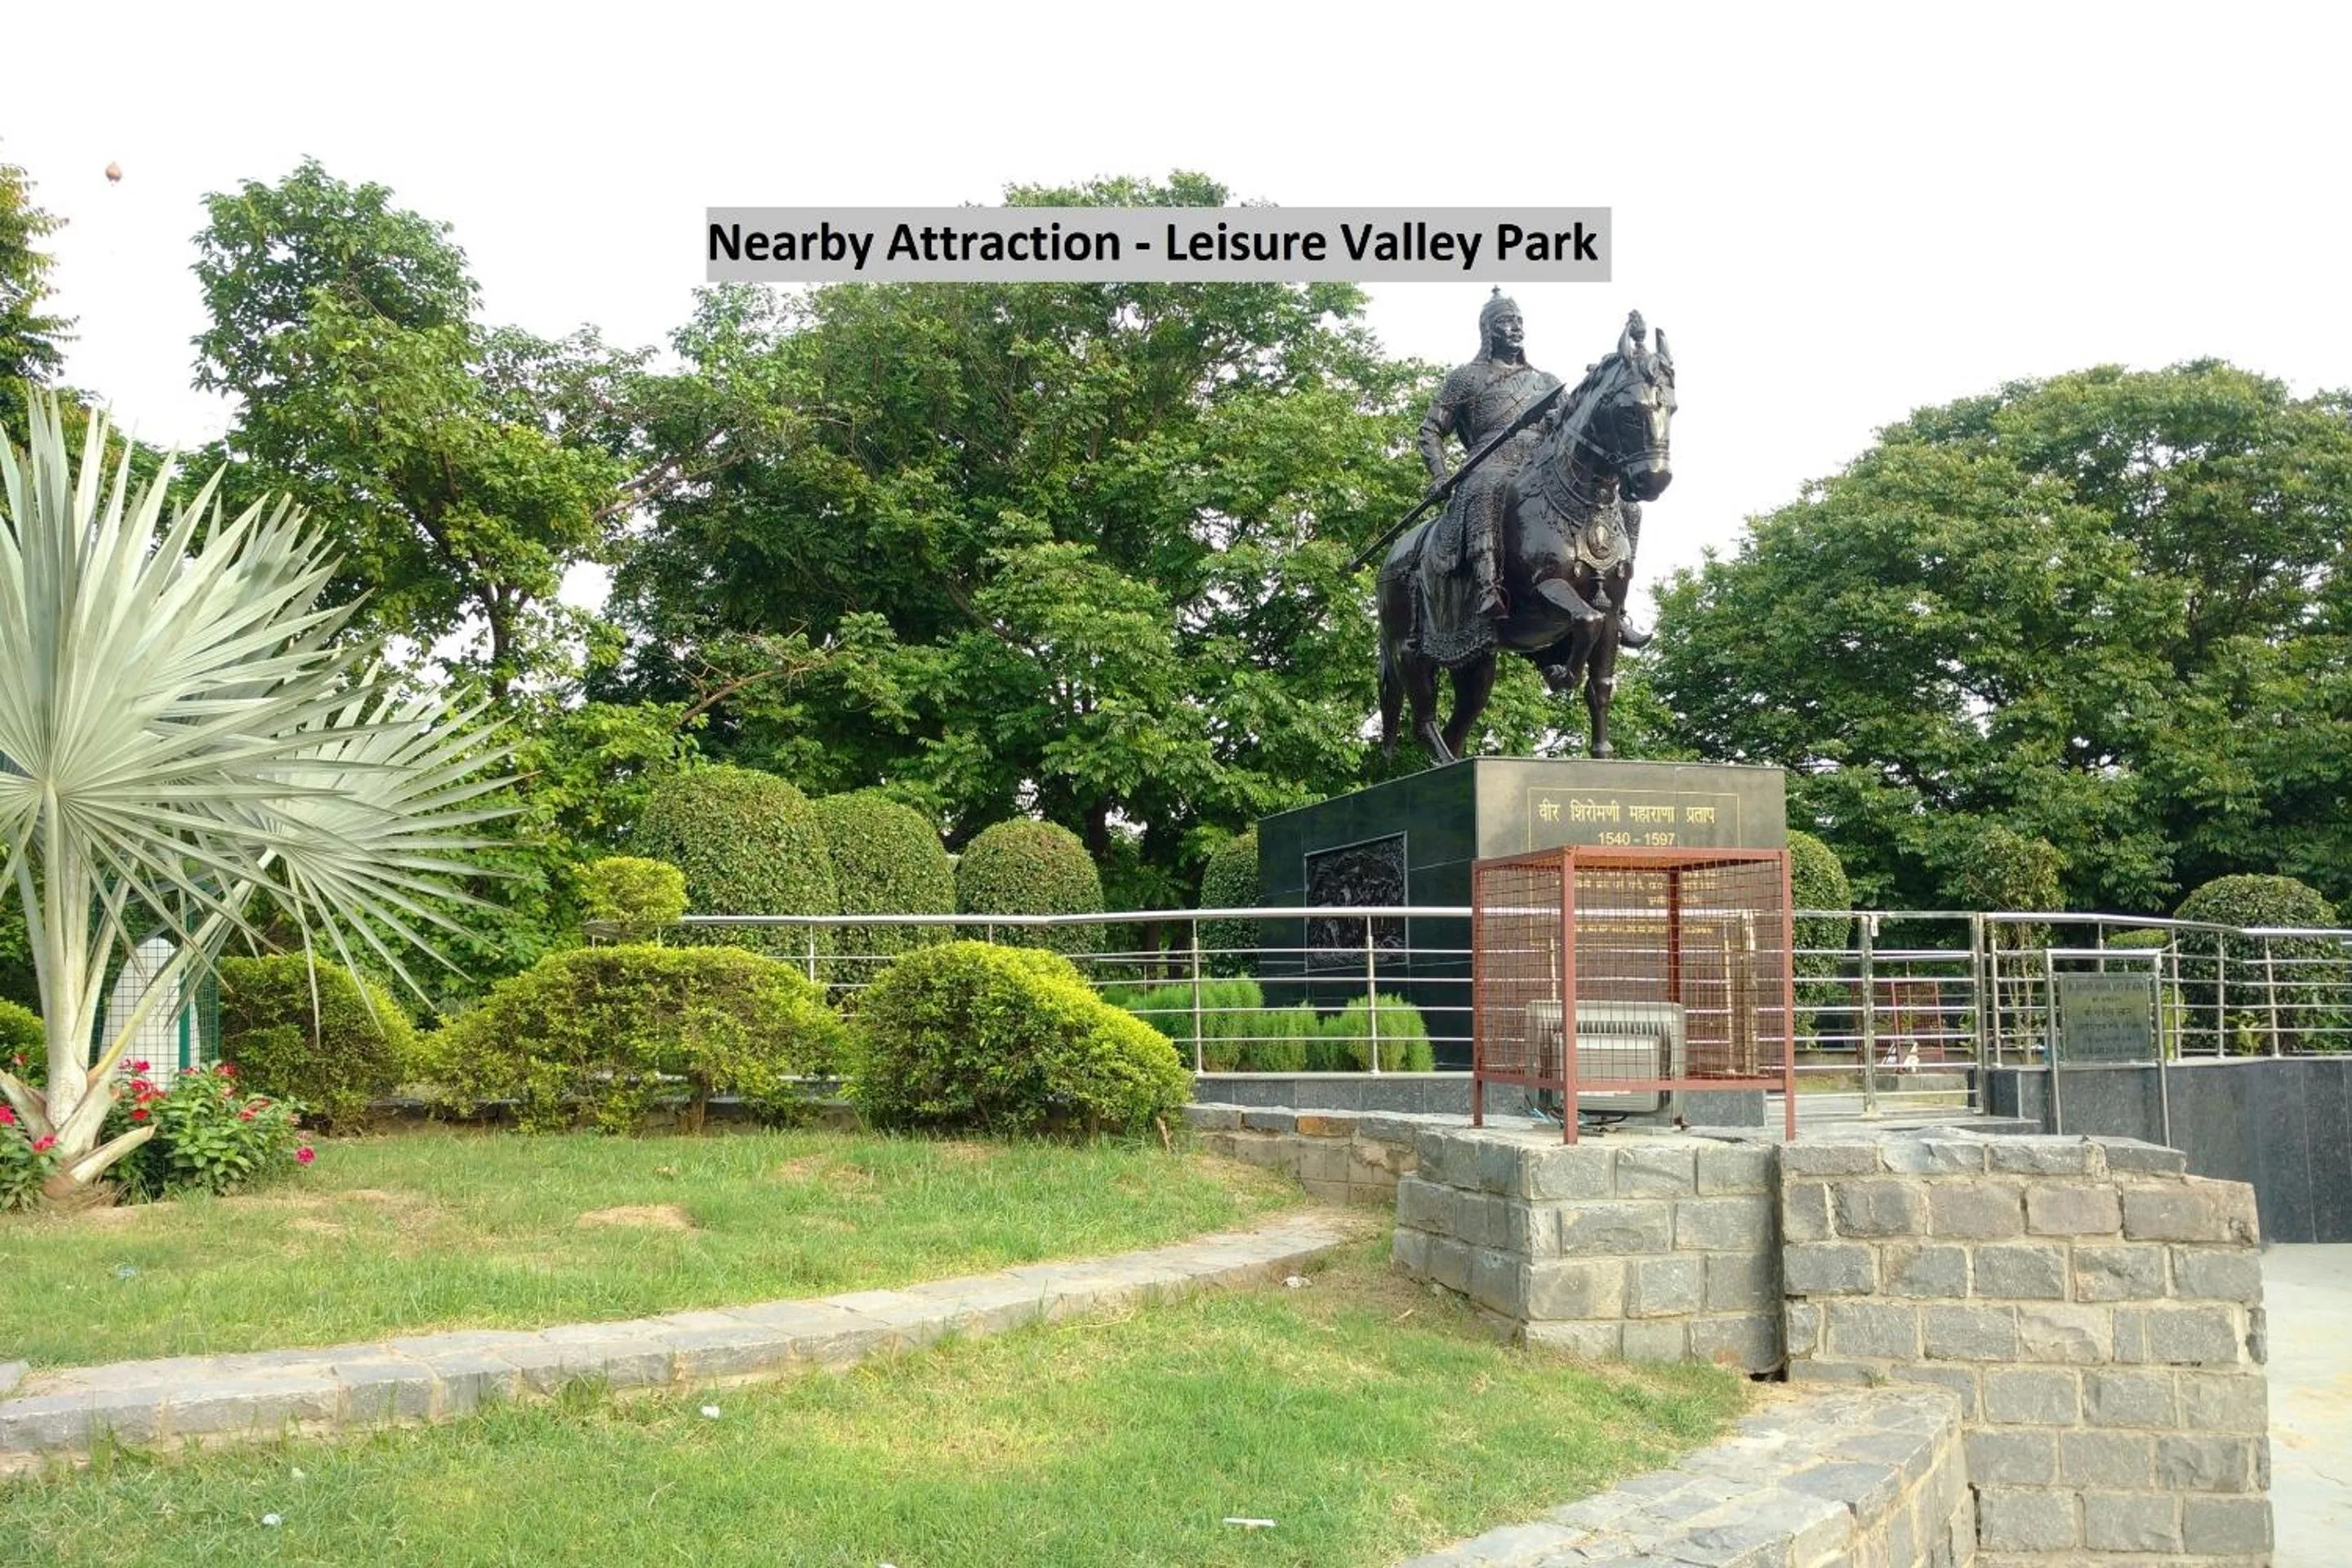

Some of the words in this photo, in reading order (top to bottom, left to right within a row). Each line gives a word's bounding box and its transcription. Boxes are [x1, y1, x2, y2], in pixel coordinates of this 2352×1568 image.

[1538, 798, 1561, 822] वीर
[1570, 798, 1620, 822] शिरोमणी
[1628, 804, 1675, 823] महाराणा
[1686, 806, 1715, 824] प्रताप
[1597, 831, 1631, 845] 1540
[1643, 831, 1676, 846] 1597
